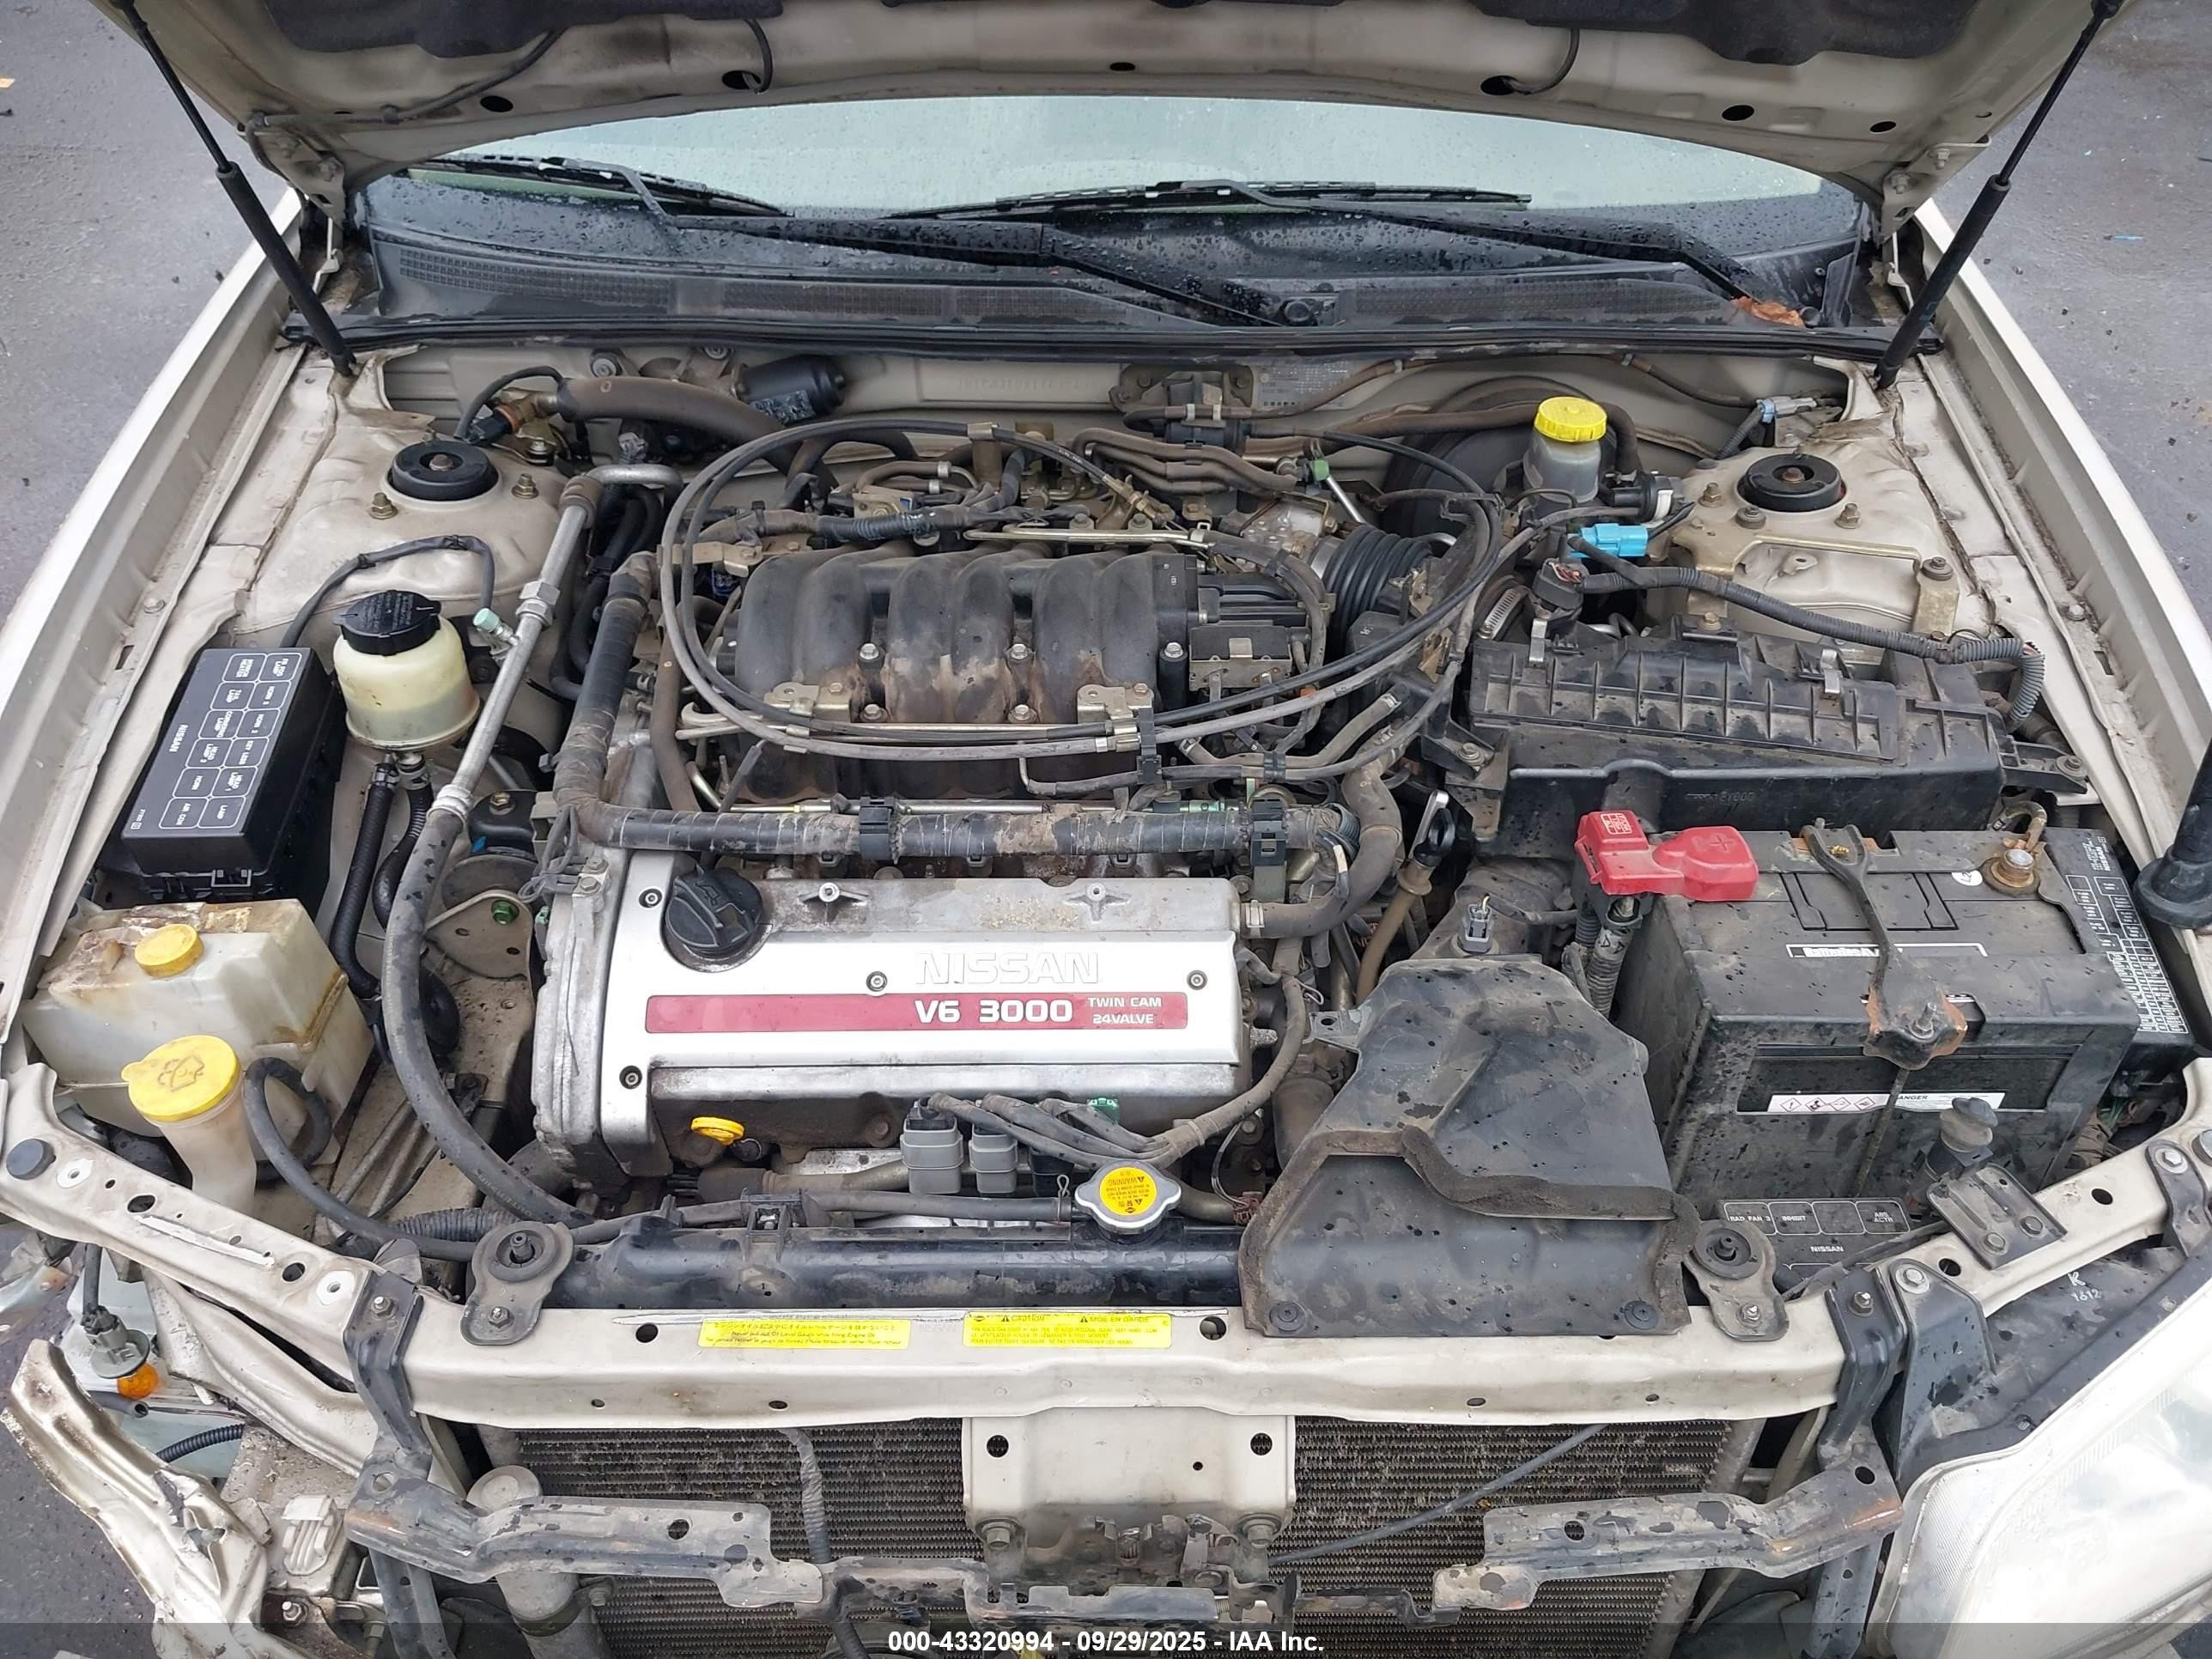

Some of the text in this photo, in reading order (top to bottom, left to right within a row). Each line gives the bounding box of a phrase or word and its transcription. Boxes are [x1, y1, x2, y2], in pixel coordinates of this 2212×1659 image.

[226, 690, 236, 703] LAMP
[233, 690, 242, 700] TAIL
[264, 686, 275, 700] HORN
[214, 718, 225, 732] LAMP
[254, 714, 264, 727] HORN
[169, 725, 188, 752] NISSAN
[204, 744, 214, 757] LAMP
[208, 746, 219, 760] HEAD
[239, 740, 254, 764] KEY LESS
[191, 776, 204, 790] HORN
[228, 772, 239, 786] LAMP
[232, 775, 243, 788] HEAD
[175, 803, 191, 824] AIR CON
[217, 805, 228, 819] LAMP
[915, 952, 1098, 984] NISSAN
[1087, 997, 1162, 1007] TWIN CAM
[915, 1000, 1073, 1024] V6 3000
[1092, 1013, 1154, 1024] 24VALVE
[1108, 1177, 1137, 1186] WARNING
